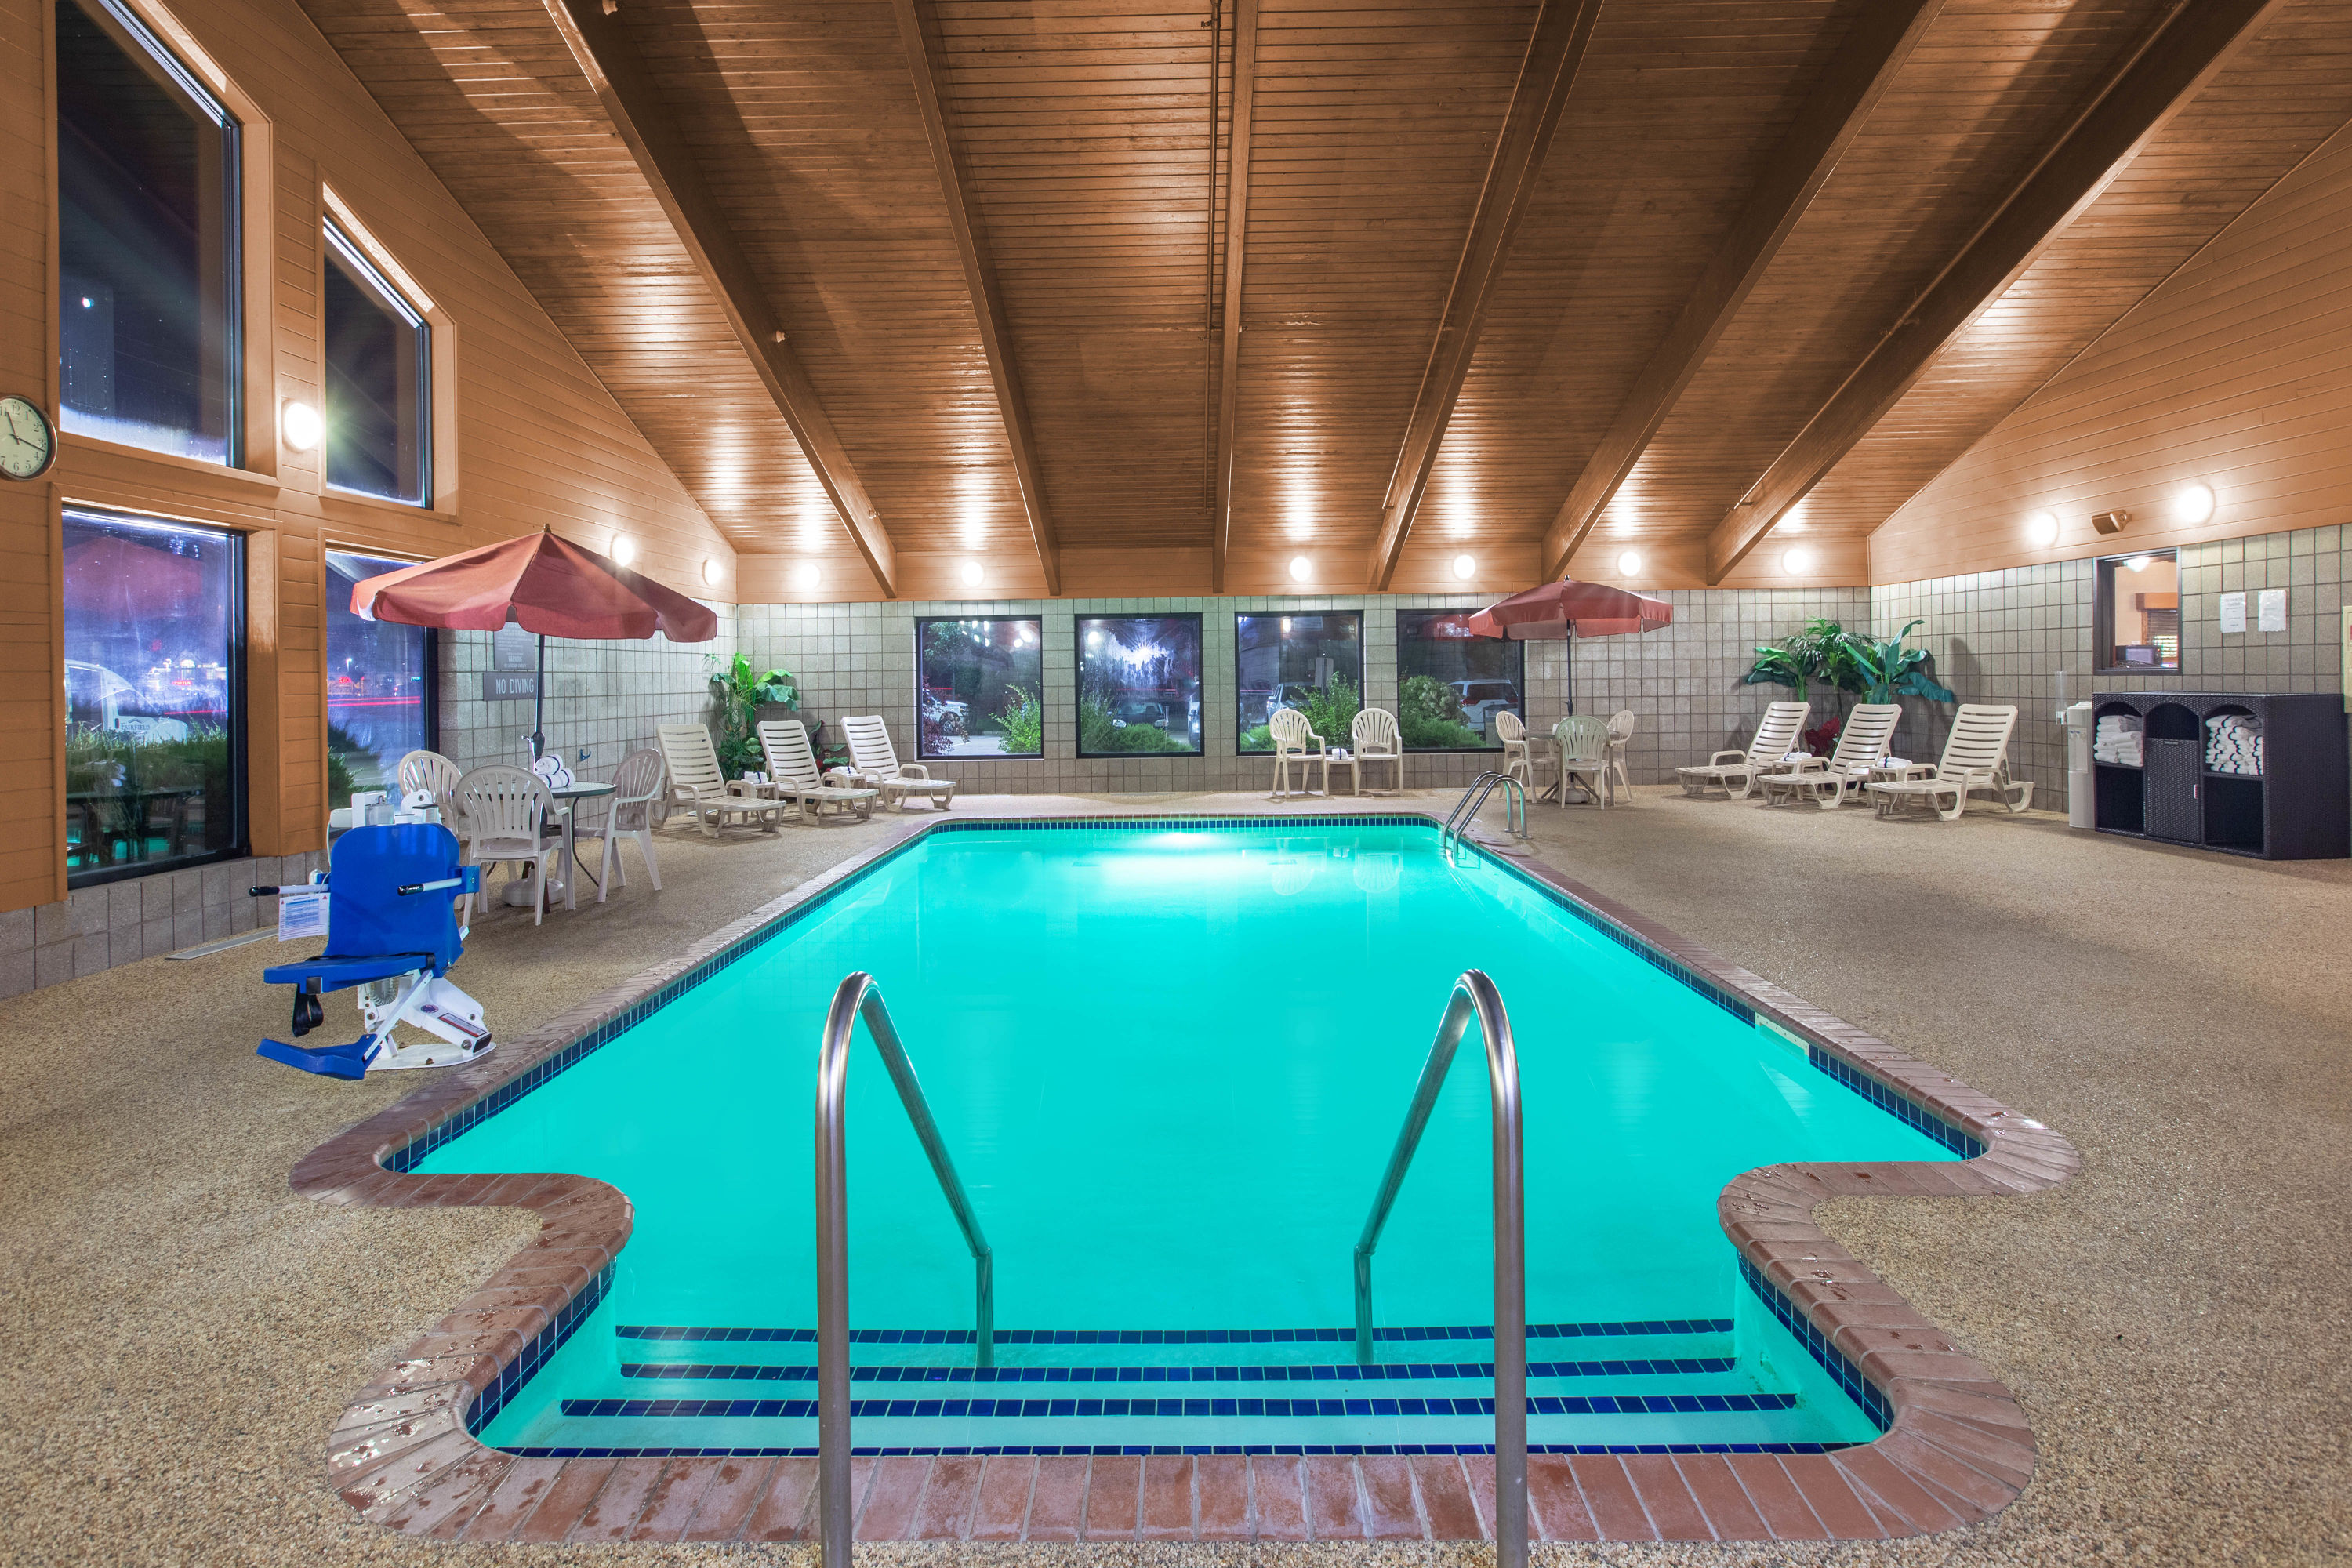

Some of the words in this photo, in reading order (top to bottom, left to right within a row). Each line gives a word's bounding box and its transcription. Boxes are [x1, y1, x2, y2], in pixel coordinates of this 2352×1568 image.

[12, 404, 20, 416] 12
[33, 423, 40, 433] 2
[38, 438, 44, 448] 3
[1, 456, 6, 466] 7
[34, 451, 39, 461] 4
[13, 461, 20, 472] 6
[25, 459, 31, 470] 5
[495, 679, 506, 694] NO
[510, 678, 535, 694] DIVING
[121, 722, 151, 731] FAIRFIELD
